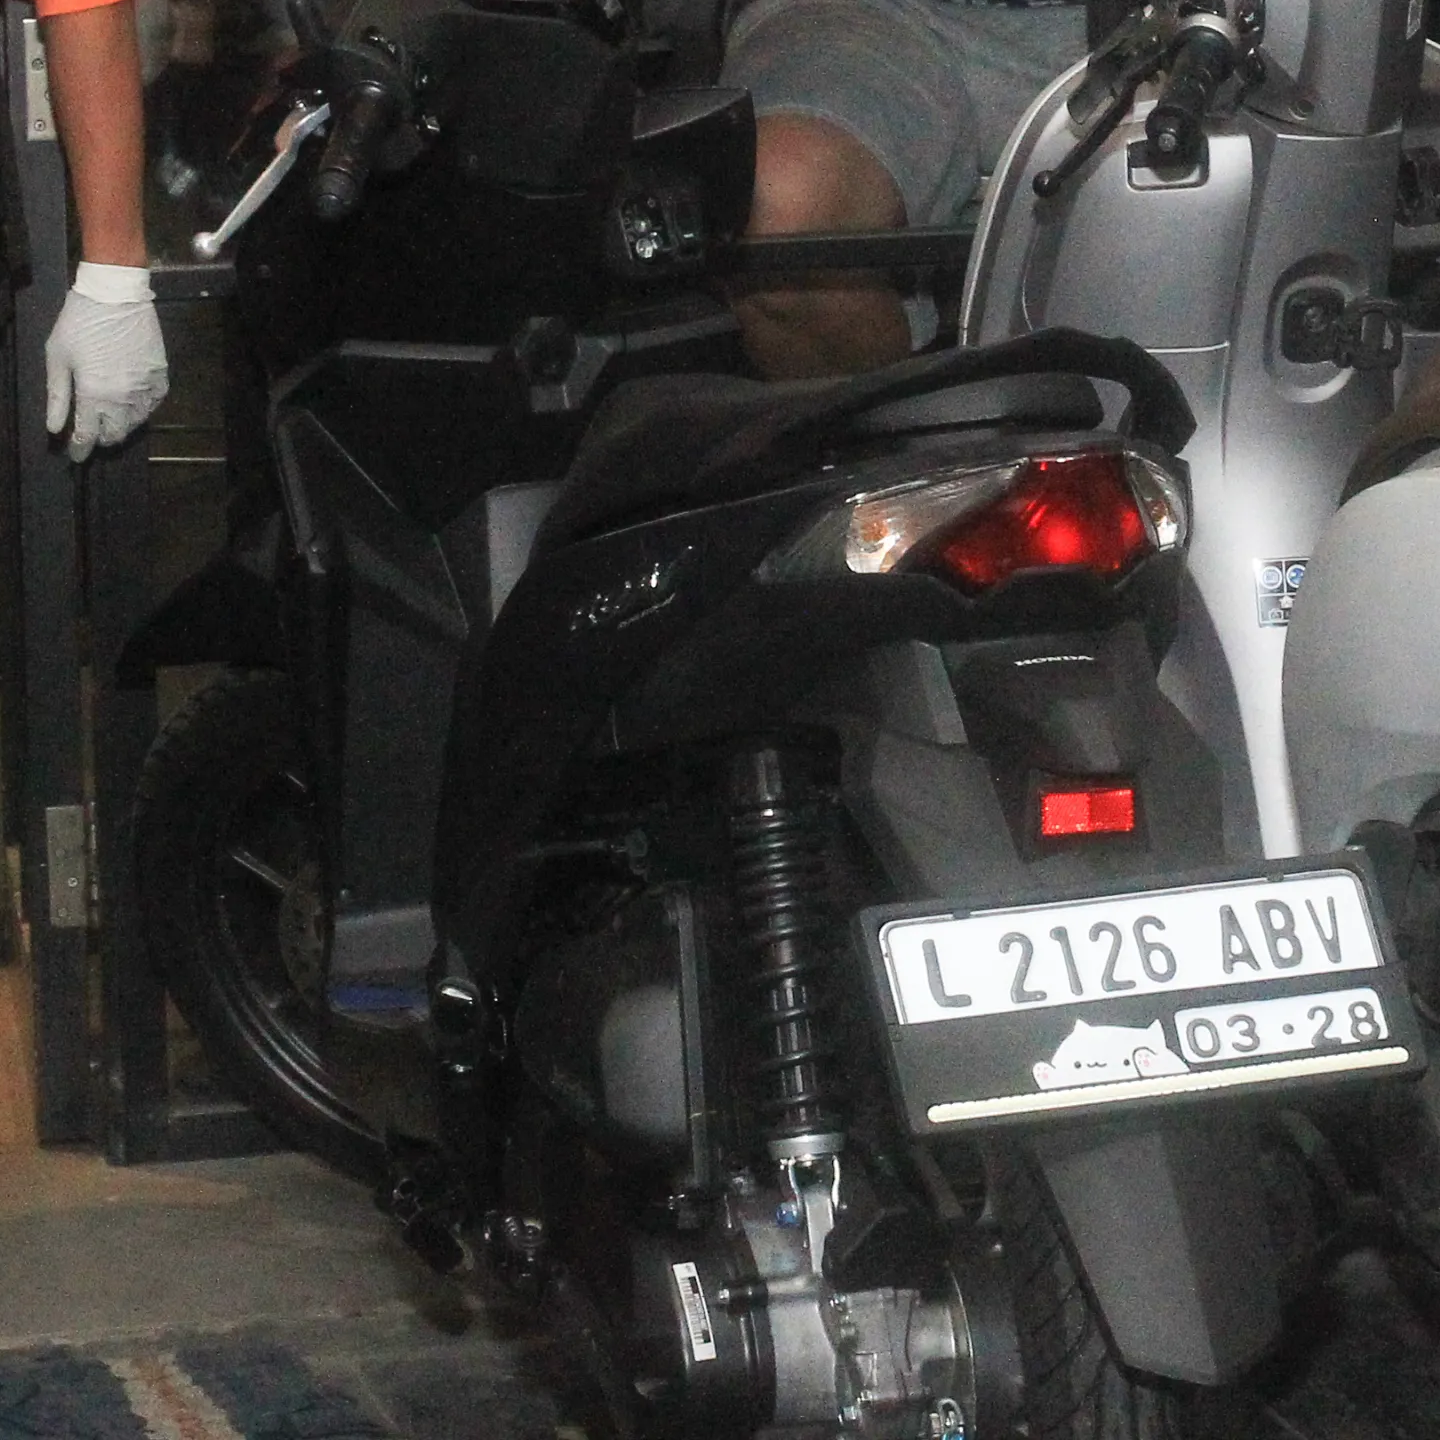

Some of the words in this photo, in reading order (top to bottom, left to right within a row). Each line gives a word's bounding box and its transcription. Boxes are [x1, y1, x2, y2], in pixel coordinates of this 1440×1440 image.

[921, 937, 973, 1009] L
[998, 914, 1178, 1004] 2126
[1218, 894, 1344, 975] ABV
